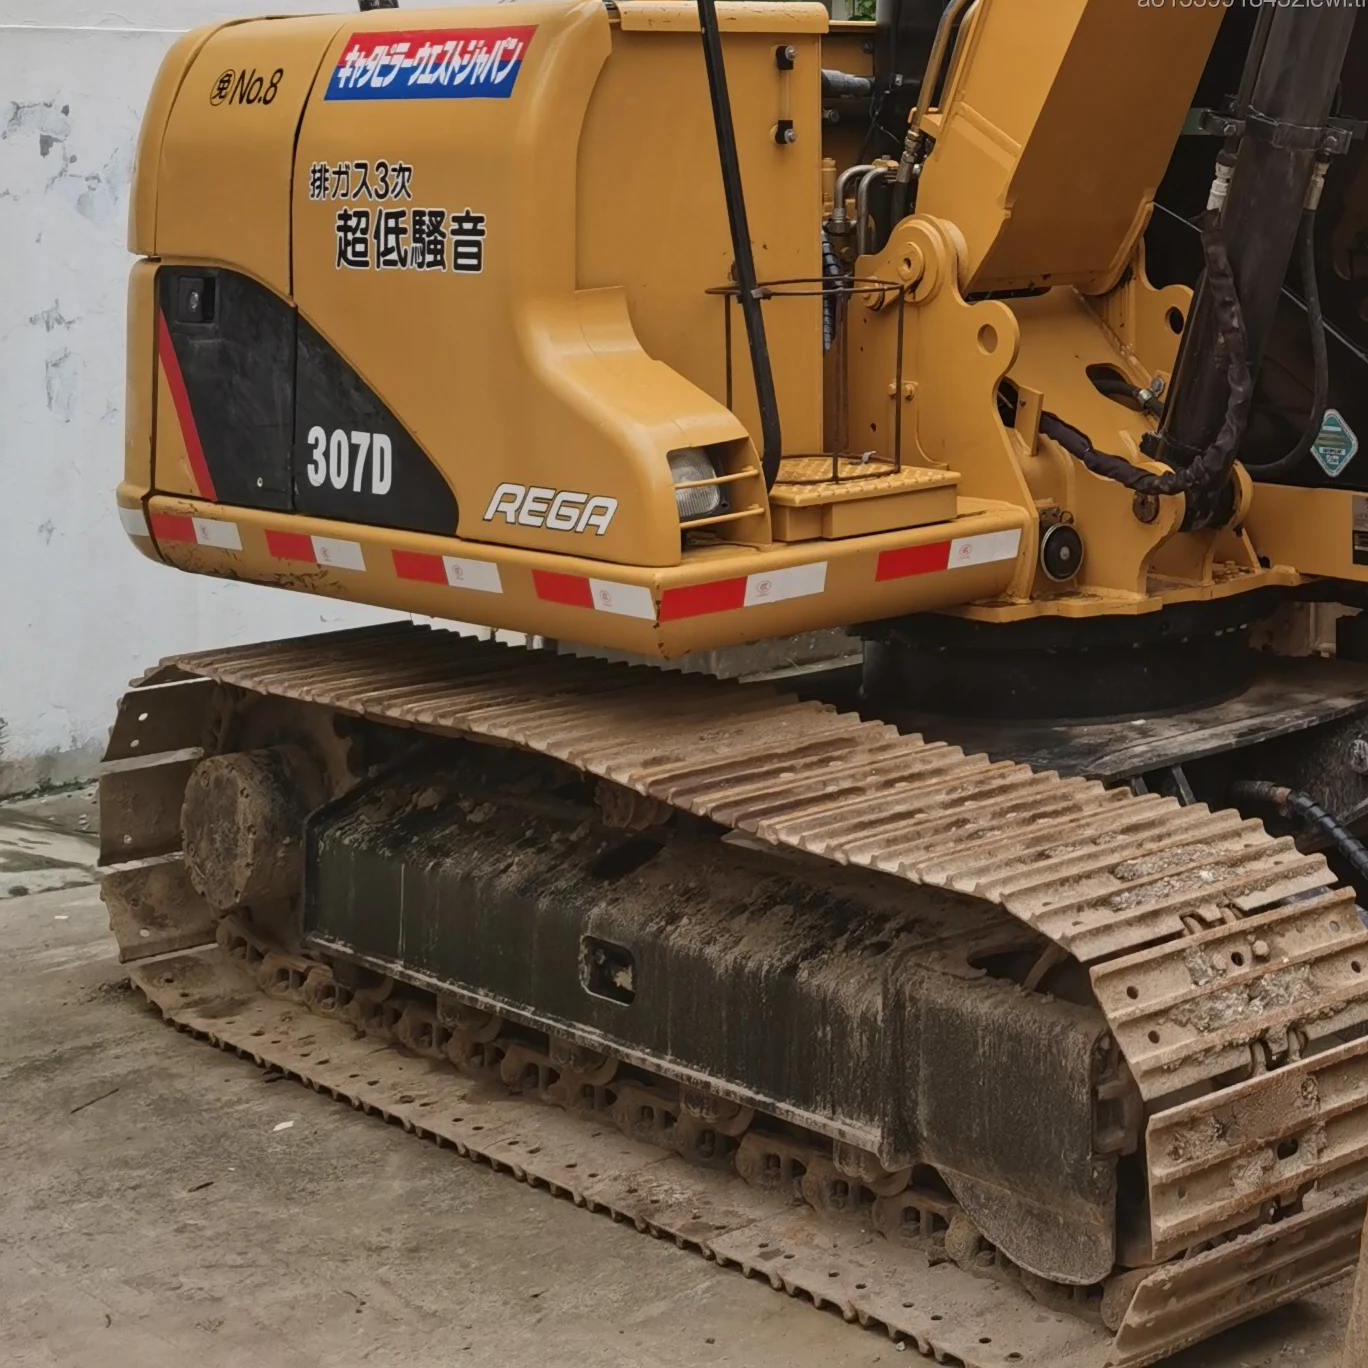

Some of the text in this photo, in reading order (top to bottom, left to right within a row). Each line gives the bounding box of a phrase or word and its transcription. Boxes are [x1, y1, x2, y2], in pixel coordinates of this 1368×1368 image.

[338, 37, 524, 88] キャタピラーウエストジャパン
[309, 160, 413, 200] 排ガス3次
[336, 207, 486, 272] 超低騒音
[307, 426, 392, 495] 307D
[483, 482, 618, 536] REGA
